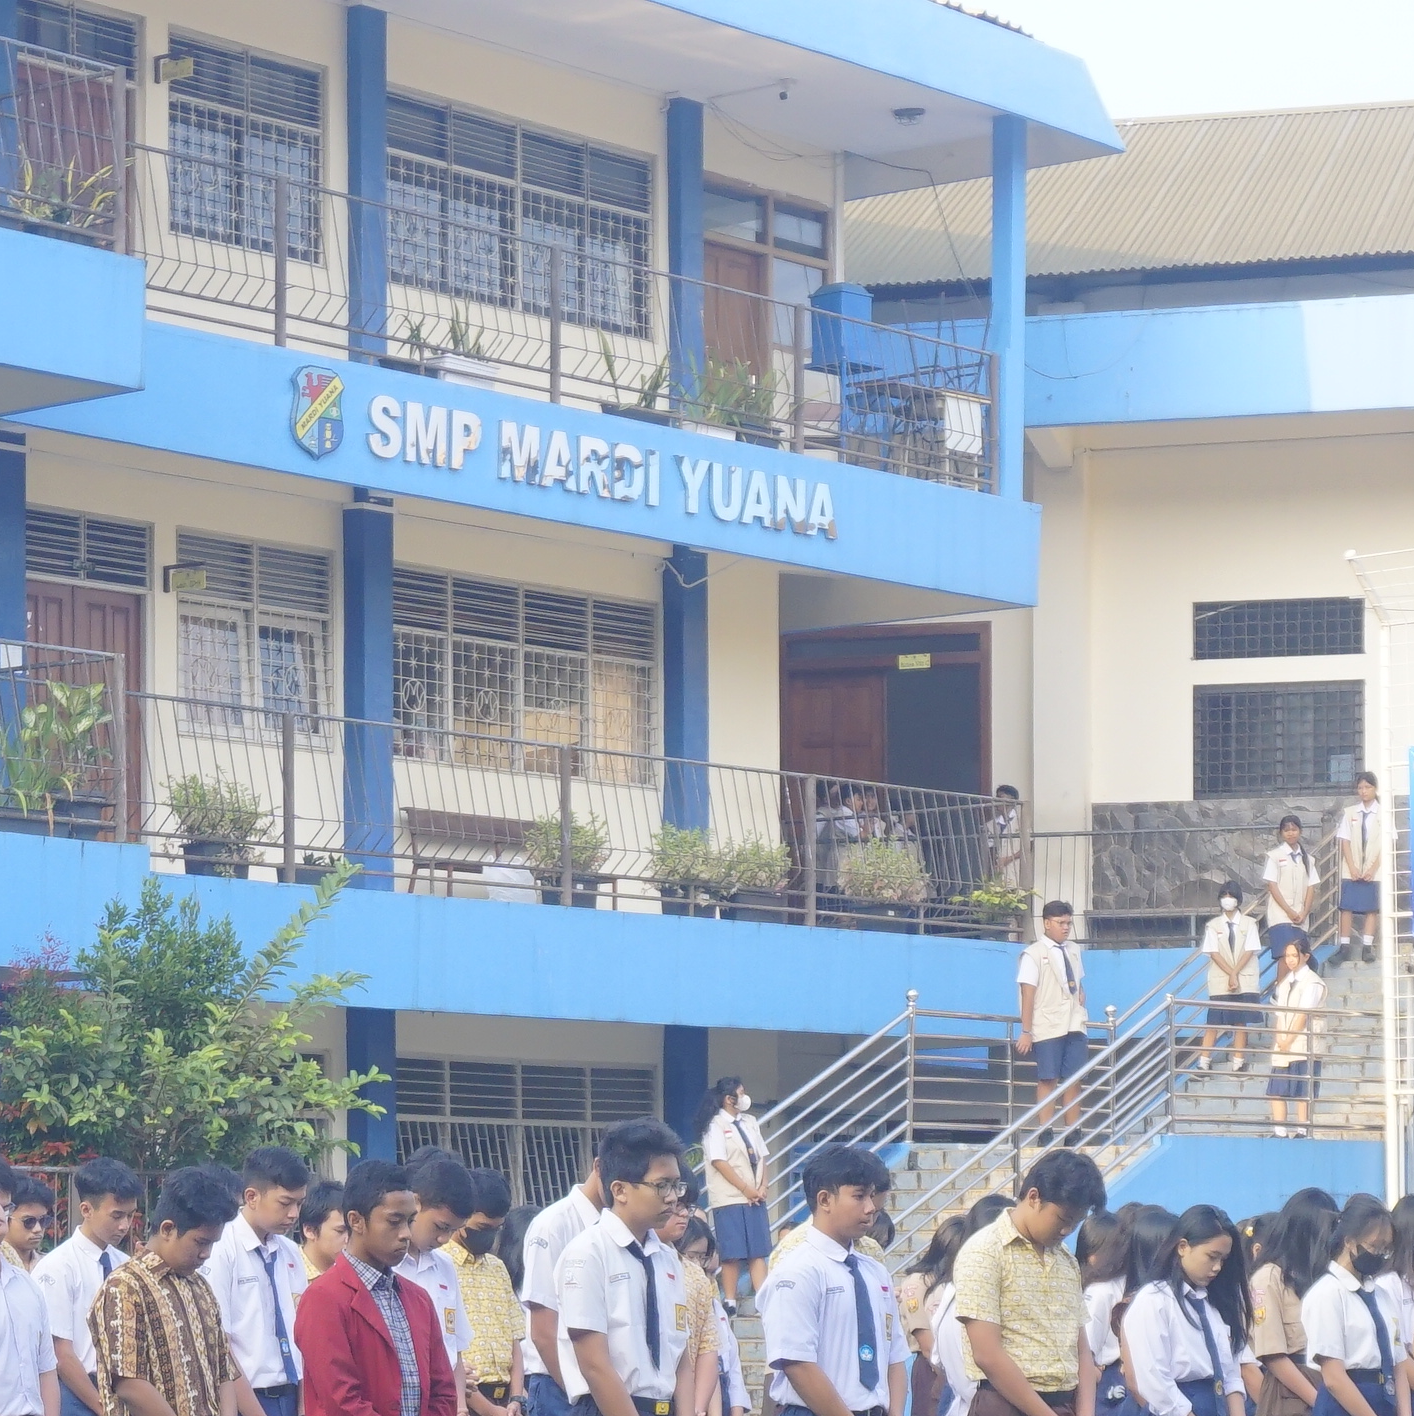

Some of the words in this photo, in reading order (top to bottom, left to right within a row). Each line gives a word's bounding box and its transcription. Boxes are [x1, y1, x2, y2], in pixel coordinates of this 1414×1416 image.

[301, 409, 319, 430] MARDI
[318, 385, 339, 408] YUANA
[367, 394, 482, 470] SMP
[498, 420, 660, 507] MARDI
[674, 454, 838, 539] YUANA
